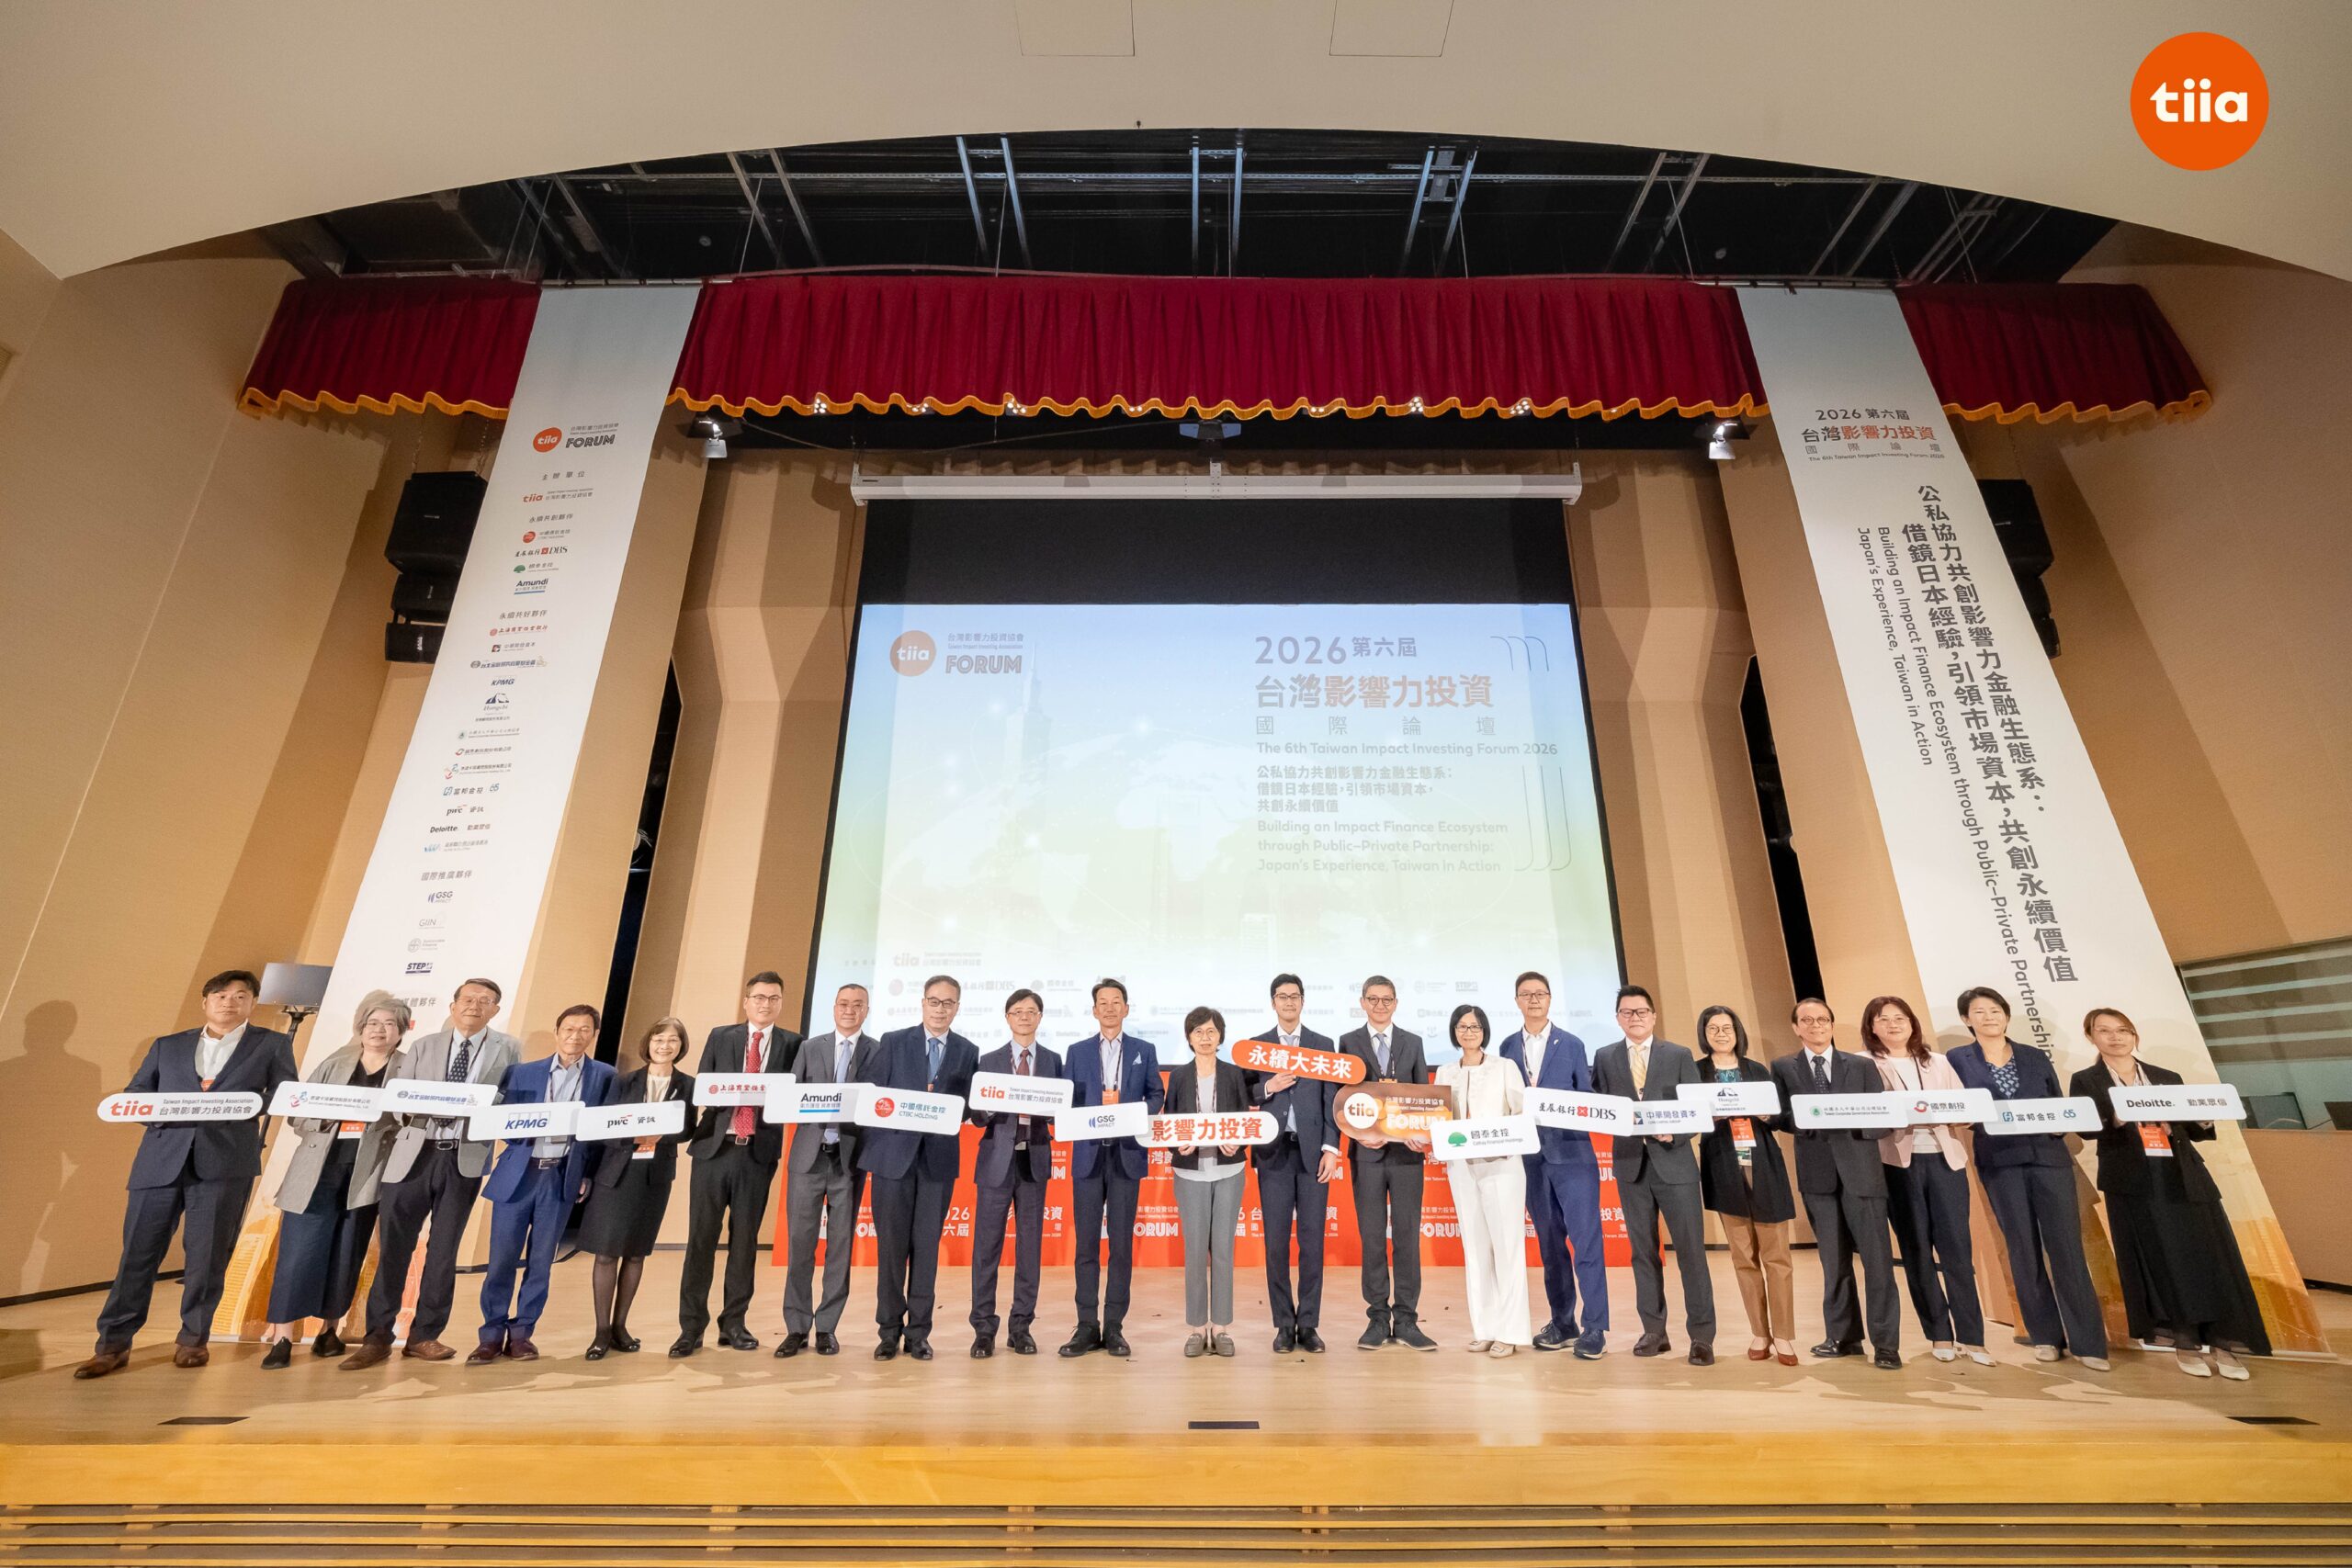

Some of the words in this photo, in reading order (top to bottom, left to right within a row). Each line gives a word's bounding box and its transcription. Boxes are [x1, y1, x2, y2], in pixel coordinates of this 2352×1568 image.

[1815, 409, 1861, 421] 2026
[1865, 408, 1910, 420] 第六屆
[537, 435, 558, 446] tiia
[566, 434, 616, 448] FORUM
[1802, 425, 1937, 443] 台灣影響力投資
[523, 493, 543, 503] tiia
[515, 578, 548, 587] Amundi
[1871, 578, 1898, 651] Experience,
[896, 644, 930, 661] tiia
[1255, 637, 1347, 665] 2026
[1351, 637, 1418, 658] 第六屆
[945, 655, 1022, 674] FORUM
[491, 678, 514, 686] KPMG
[1878, 526, 1900, 576] Building
[1893, 580, 1905, 595] an
[1899, 598, 1923, 644] Impact
[1913, 646, 1937, 698] Finance
[1929, 701, 1961, 775] Ecosystem
[1954, 778, 1984, 837] through
[1893, 654, 1914, 702] Taiwan
[1255, 673, 1495, 709] 台灣影響力投資
[1907, 705, 1920, 717] in
[1256, 716, 1496, 736] 國際論壇
[1257, 742, 1281, 755] The
[1284, 742, 1307, 755] 6th
[1309, 742, 1358, 755] Taiwan
[1362, 743, 1408, 758] Impact
[1412, 743, 1474, 758] Investing
[1477, 743, 1520, 755] Forum
[1523, 743, 1558, 755] 2026
[1912, 720, 1933, 765] Action
[447, 807, 463, 816] pwc
[1258, 820, 1311, 834] Building
[1314, 823, 1330, 833] an
[1334, 821, 1380, 835] Impact
[1383, 821, 1435, 833] Finance
[1438, 822, 1509, 836] Ecosystem
[1258, 840, 1310, 855] through
[1412, 840, 1494, 856] Partnership:
[1313, 860, 1389, 874] Experience,
[1392, 860, 1440, 872] Taiwan
[1442, 860, 1454, 872] in
[1458, 861, 1501, 872] Action
[435, 891, 453, 899] GSG
[1248, 1045, 1352, 1079] 永續大未來
[800, 1093, 842, 1102] Amundi
[979, 1086, 1005, 1100] tiia
[110, 1100, 153, 1116] tiia
[159, 1106, 253, 1116] 台灣影響力投資協會
[900, 1102, 946, 1113] 中國信託金控
[1348, 1103, 1375, 1118] tiia
[1539, 1102, 1576, 1116] 星展銀行
[1589, 1107, 1616, 1121] DBS
[505, 1118, 548, 1130] KPMG
[607, 1118, 628, 1128] pwc
[1097, 1114, 1115, 1123] GSG
[1151, 1117, 1262, 1142] 影響力投資
[1471, 1128, 1509, 1139] 國泰金控
[1134, 1222, 1179, 1237] ORUM
